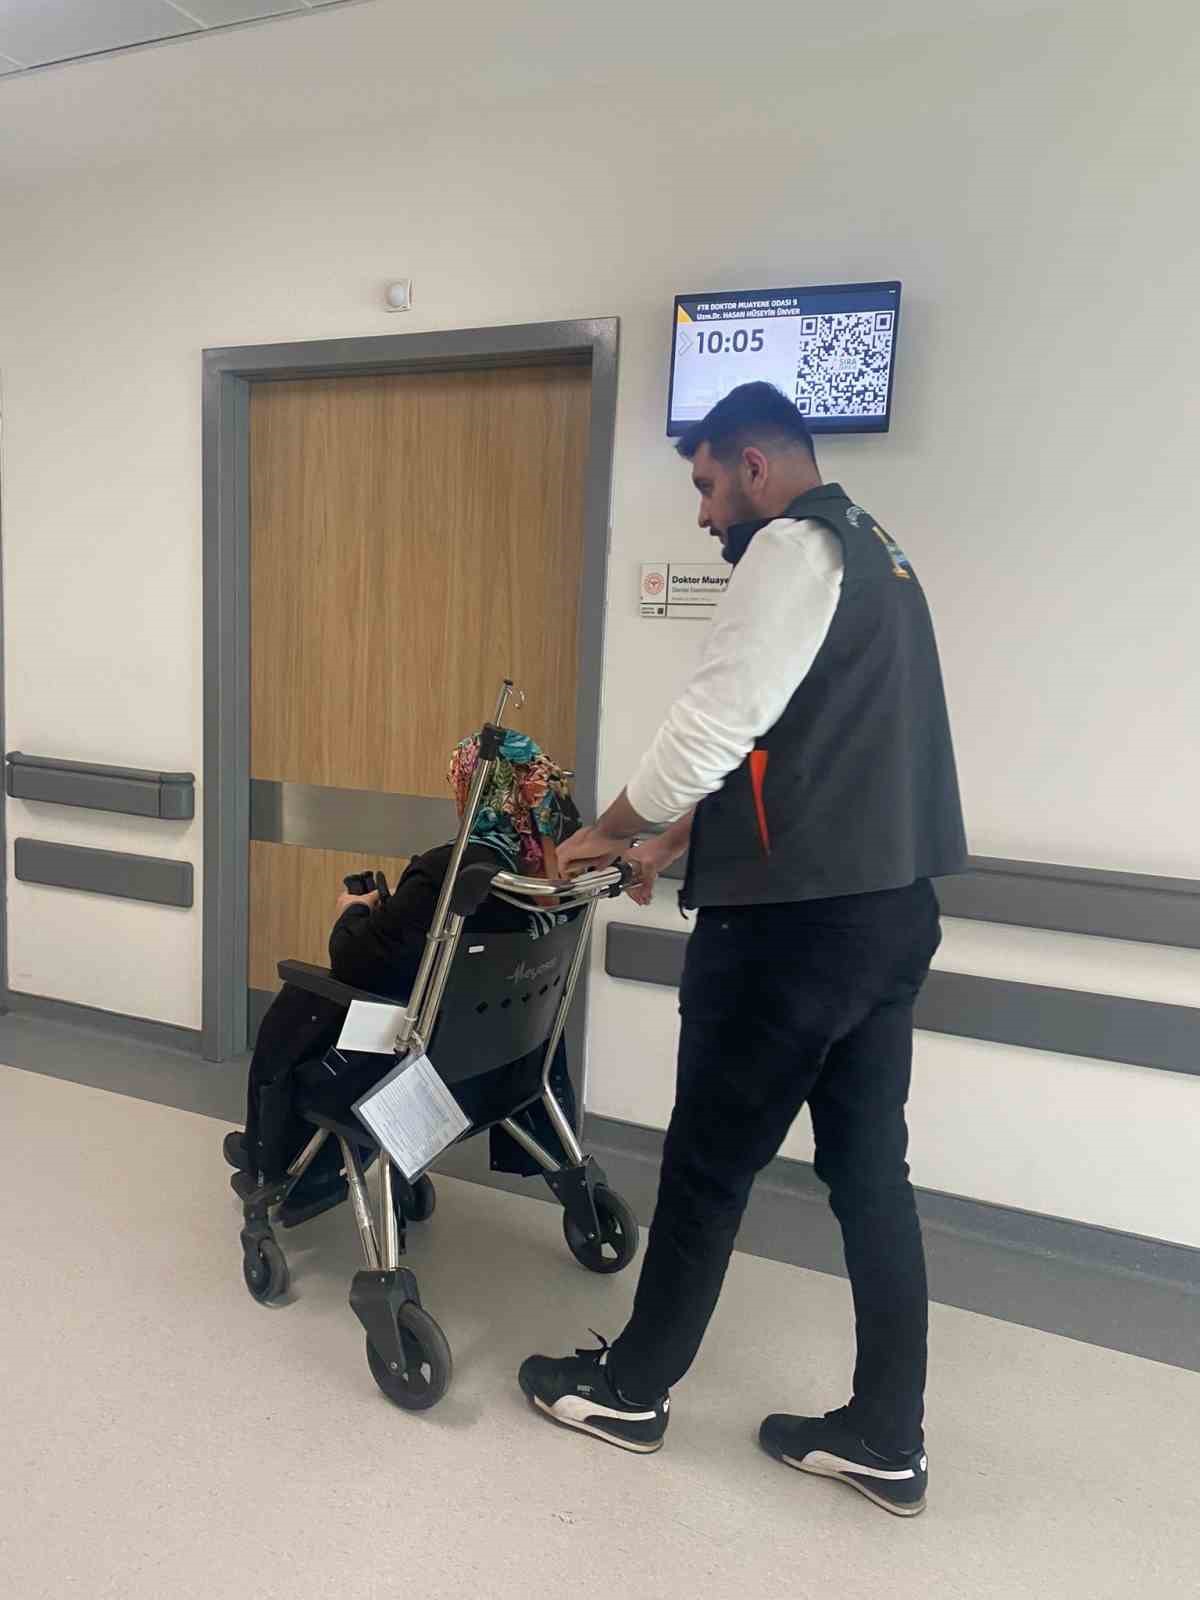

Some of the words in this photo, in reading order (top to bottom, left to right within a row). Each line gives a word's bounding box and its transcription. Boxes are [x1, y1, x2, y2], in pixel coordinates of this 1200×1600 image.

[710, 302, 737, 310] DOKTOR
[738, 301, 770, 309] MUAYENE
[771, 299, 792, 307] ODASI
[722, 311, 746, 319] HASAN
[697, 328, 764, 354] 10:05
[671, 575, 700, 584] Doktor
